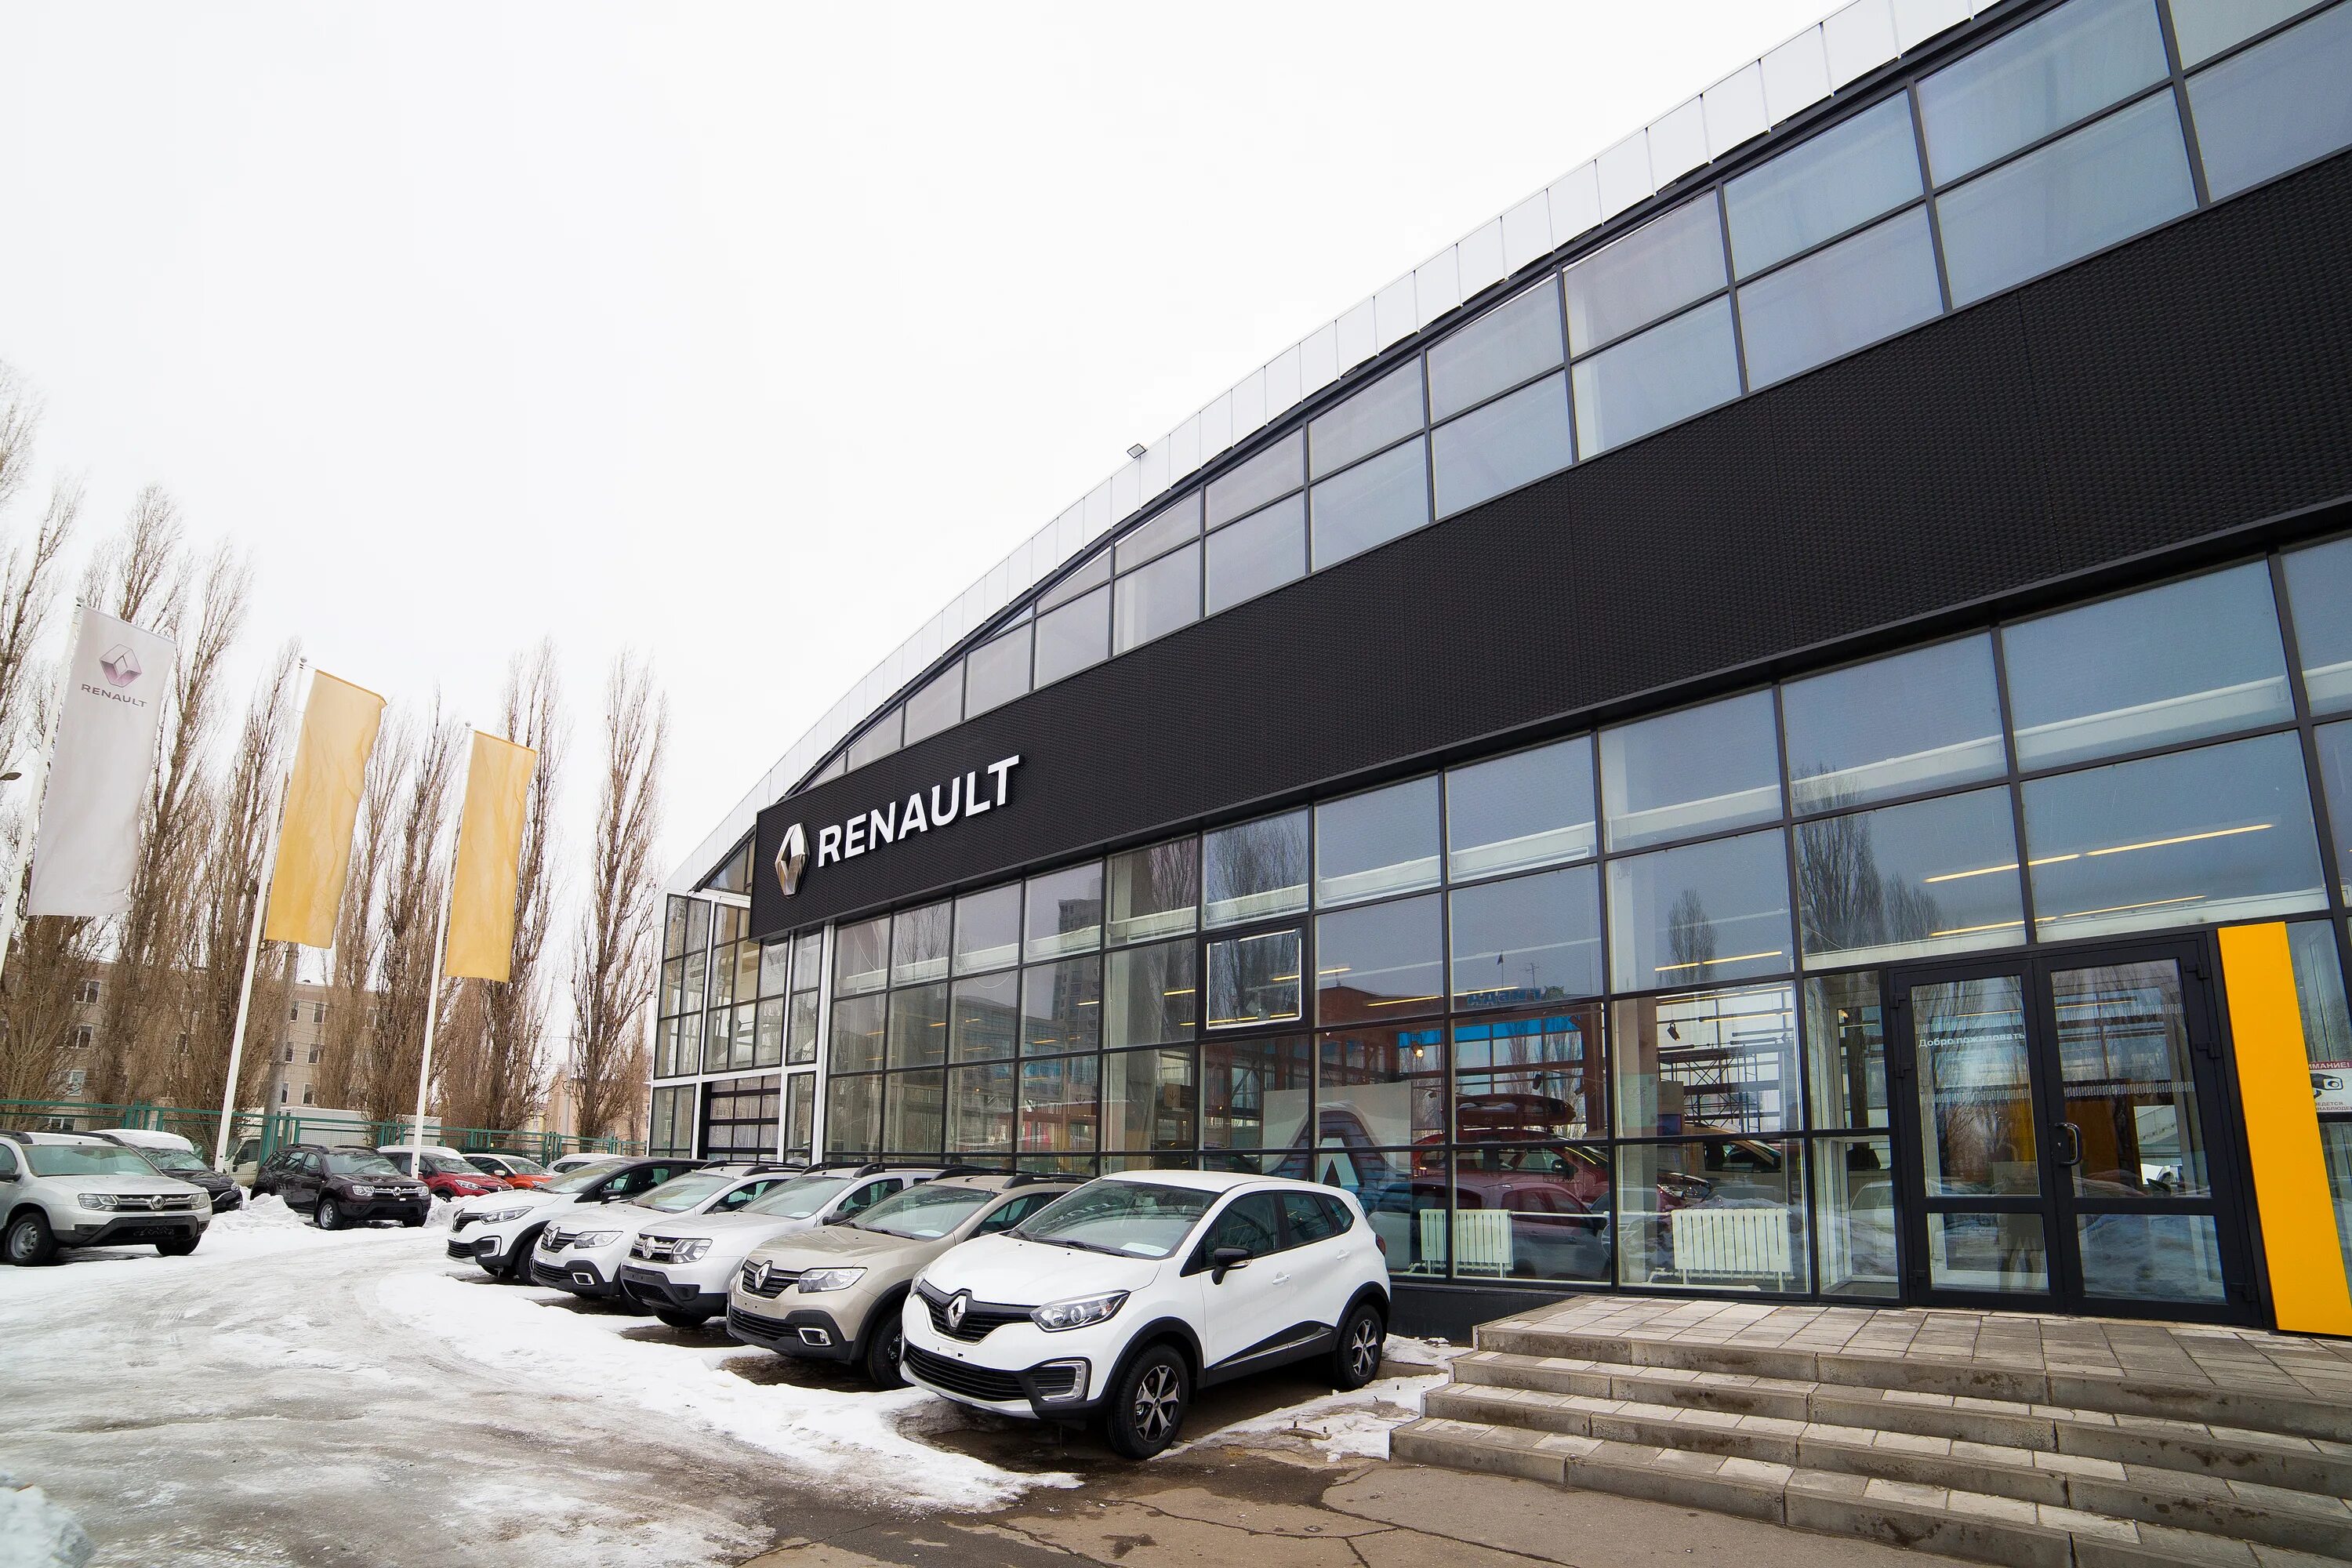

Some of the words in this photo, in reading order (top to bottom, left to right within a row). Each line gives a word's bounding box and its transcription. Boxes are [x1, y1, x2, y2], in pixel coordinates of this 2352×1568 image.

[81, 684, 147, 707] RENAULT
[818, 754, 1019, 868] RENAULT
[1918, 1037, 1954, 1047] Добро
[1957, 1033, 2025, 1044] пожаловать
